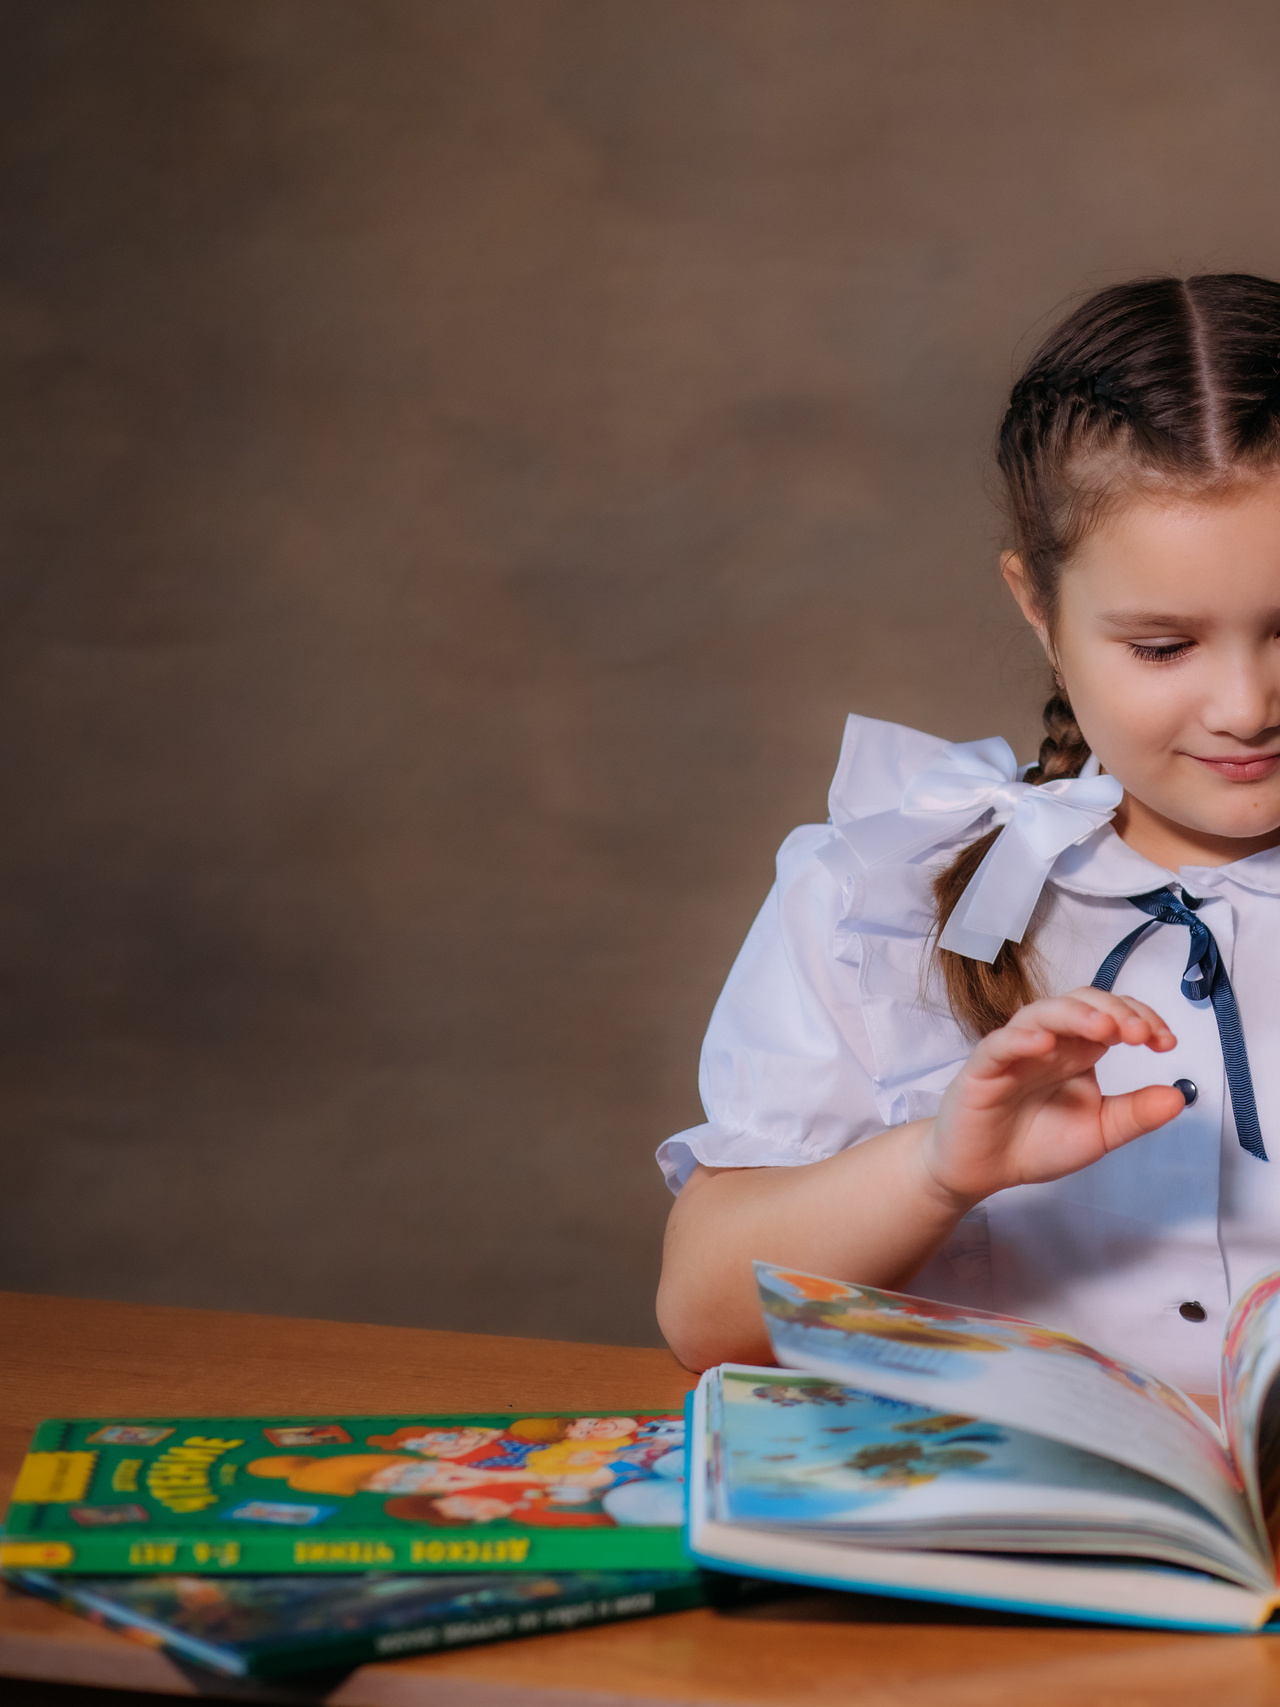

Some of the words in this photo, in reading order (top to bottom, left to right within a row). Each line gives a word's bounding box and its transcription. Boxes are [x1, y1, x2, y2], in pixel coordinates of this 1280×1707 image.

[147, 1437, 244, 1511] ЧТЕНИЕ
[295, 1540, 394, 1563] ЧТЕНИЕ
[411, 1538, 530, 1563] ДЕТСКОЕ
